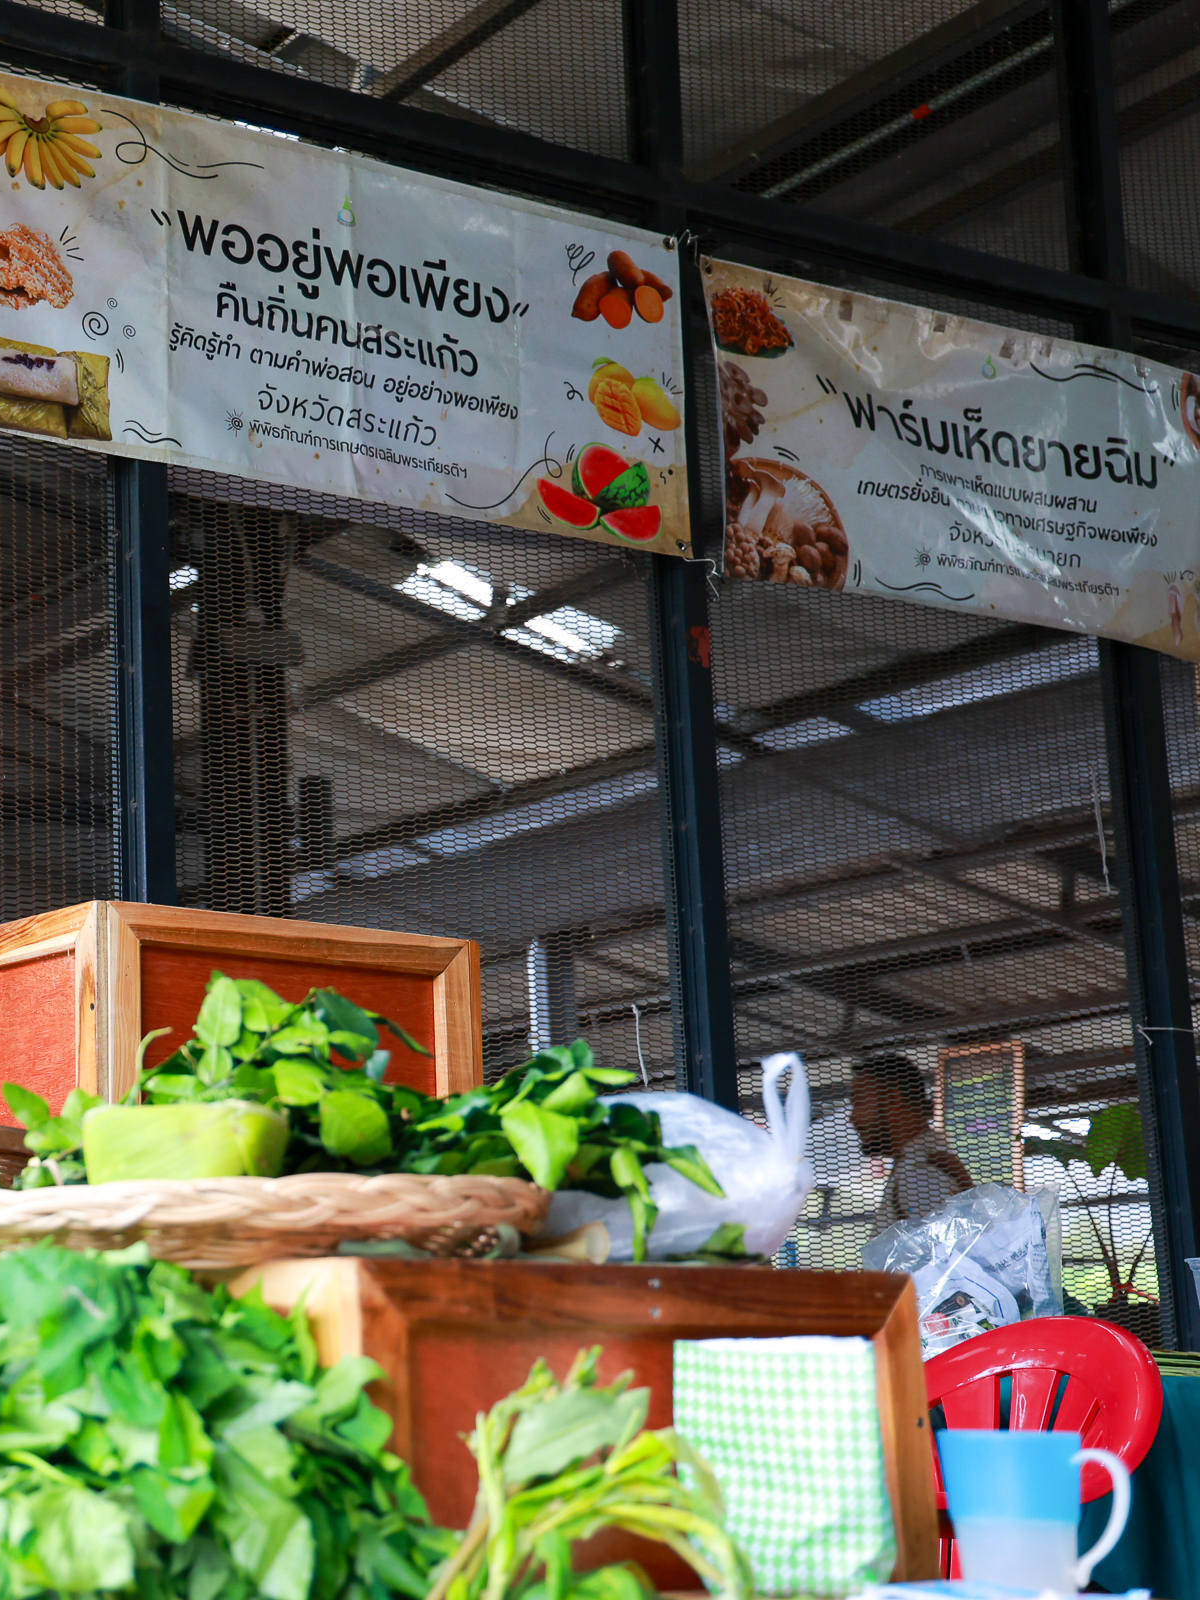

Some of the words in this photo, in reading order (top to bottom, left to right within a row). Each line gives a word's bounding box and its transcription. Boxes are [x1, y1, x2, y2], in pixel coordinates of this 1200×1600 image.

[216, 280, 479, 378] คืนถิ่นคนสระแก้ว
[169, 321, 242, 361] รู้คิดรู้ทำ
[249, 349, 377, 389] ตามคำพ่อสอน
[383, 374, 519, 420] อยู่อย่างพอเพียง
[257, 383, 438, 447] จังหวัดสระแก้ว
[856, 477, 951, 507] เกษตรยั่งยืน
[920, 463, 1098, 514] การเพาะเห็ดแบบผสมผสาน
